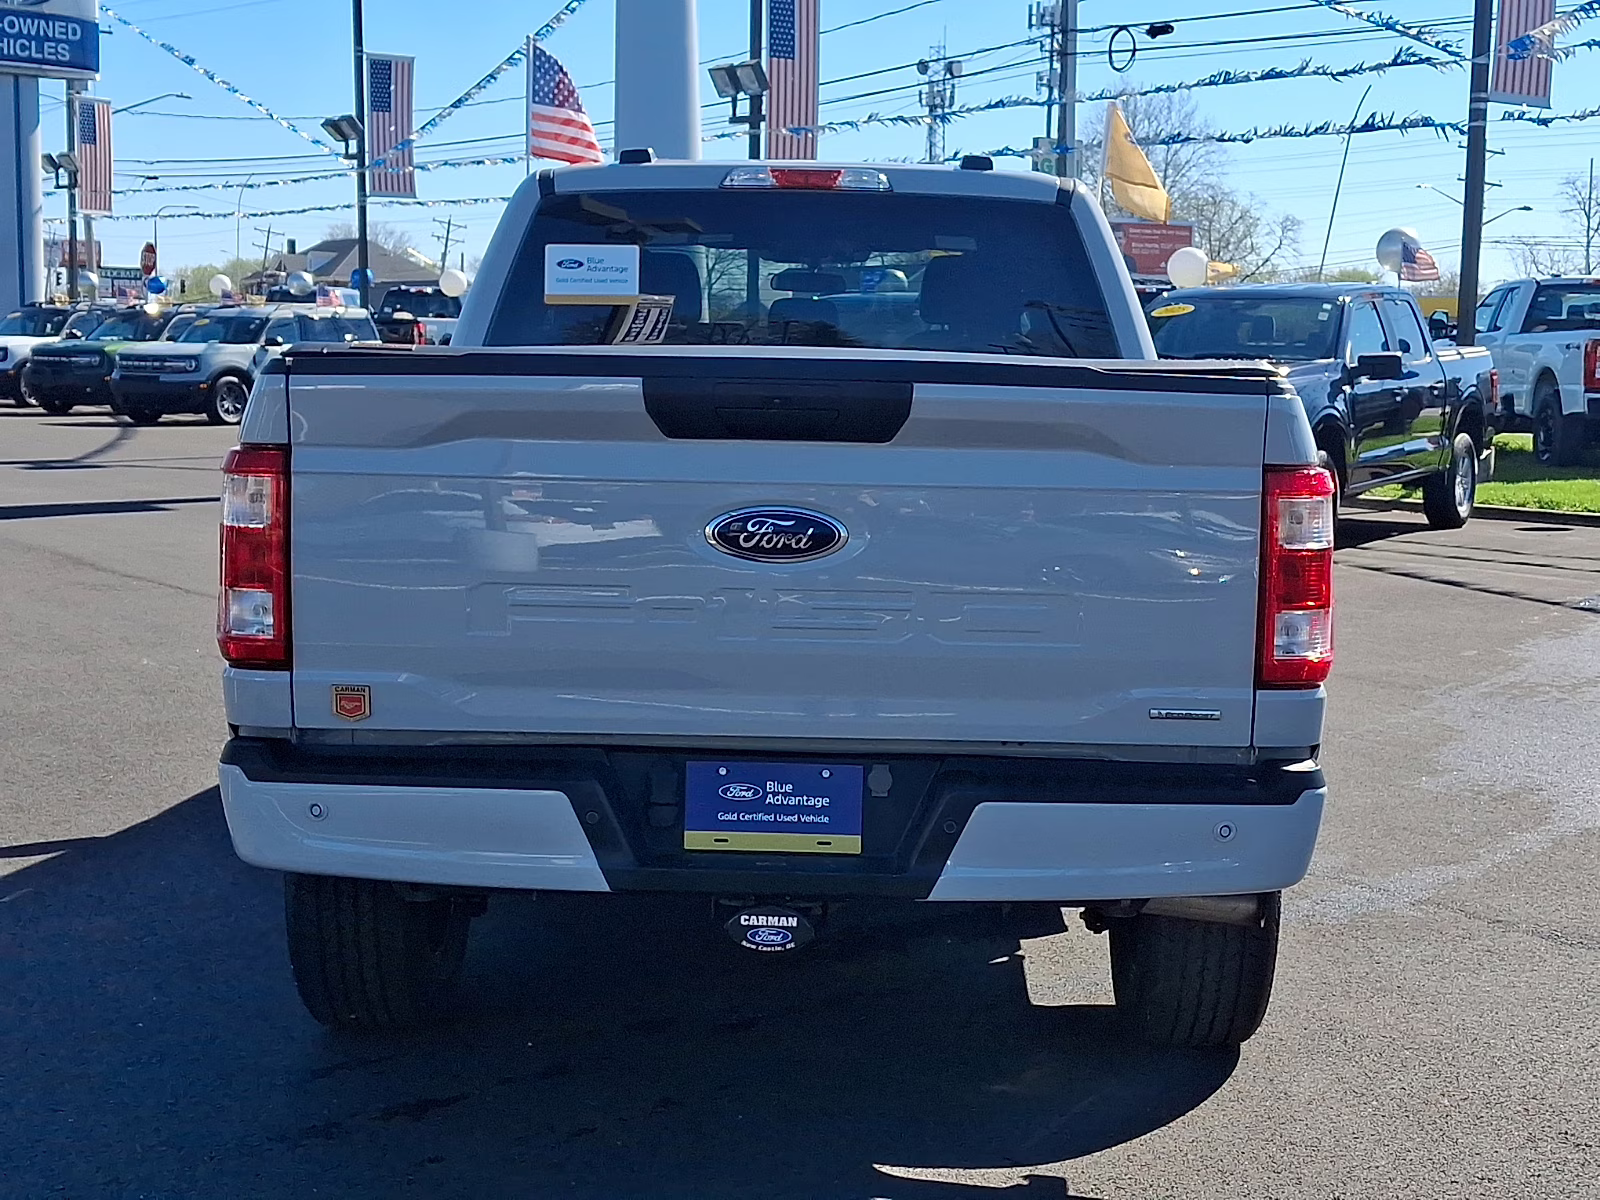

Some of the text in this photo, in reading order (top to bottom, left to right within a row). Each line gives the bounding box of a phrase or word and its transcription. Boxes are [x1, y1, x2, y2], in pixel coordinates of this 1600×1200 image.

[141, 251, 156, 266] STOP
[586, 256, 605, 264] Blue
[586, 265, 629, 274] Advantage
[739, 517, 814, 549] Ford
[766, 781, 793, 793] Blue
[765, 794, 830, 808] Advantage
[717, 811, 830, 823] Gold Certified Used Vehicle
[740, 915, 798, 927] CARMAN
